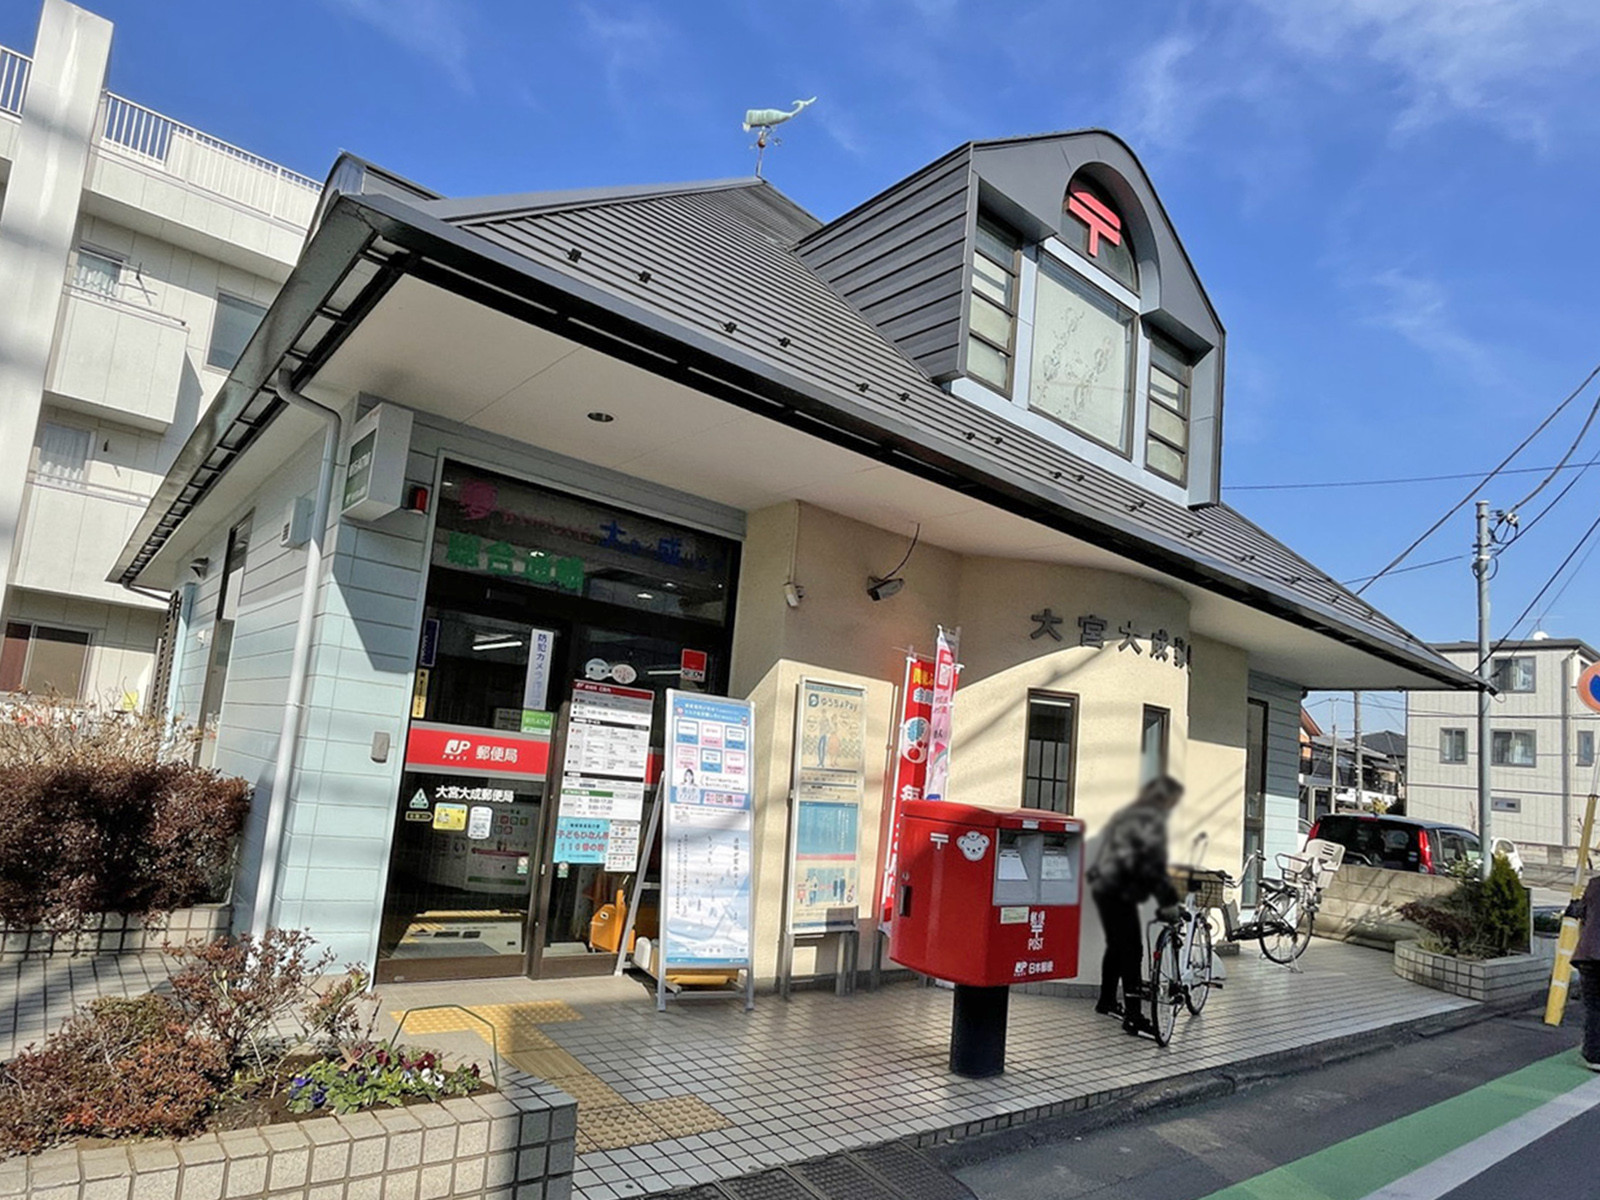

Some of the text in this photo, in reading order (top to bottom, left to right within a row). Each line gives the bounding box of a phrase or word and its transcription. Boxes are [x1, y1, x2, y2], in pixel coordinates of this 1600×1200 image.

[475, 745, 518, 763] 郵便局
[435, 785, 514, 803] 大宮大成郵便局
[1028, 938, 1044, 951] POST
